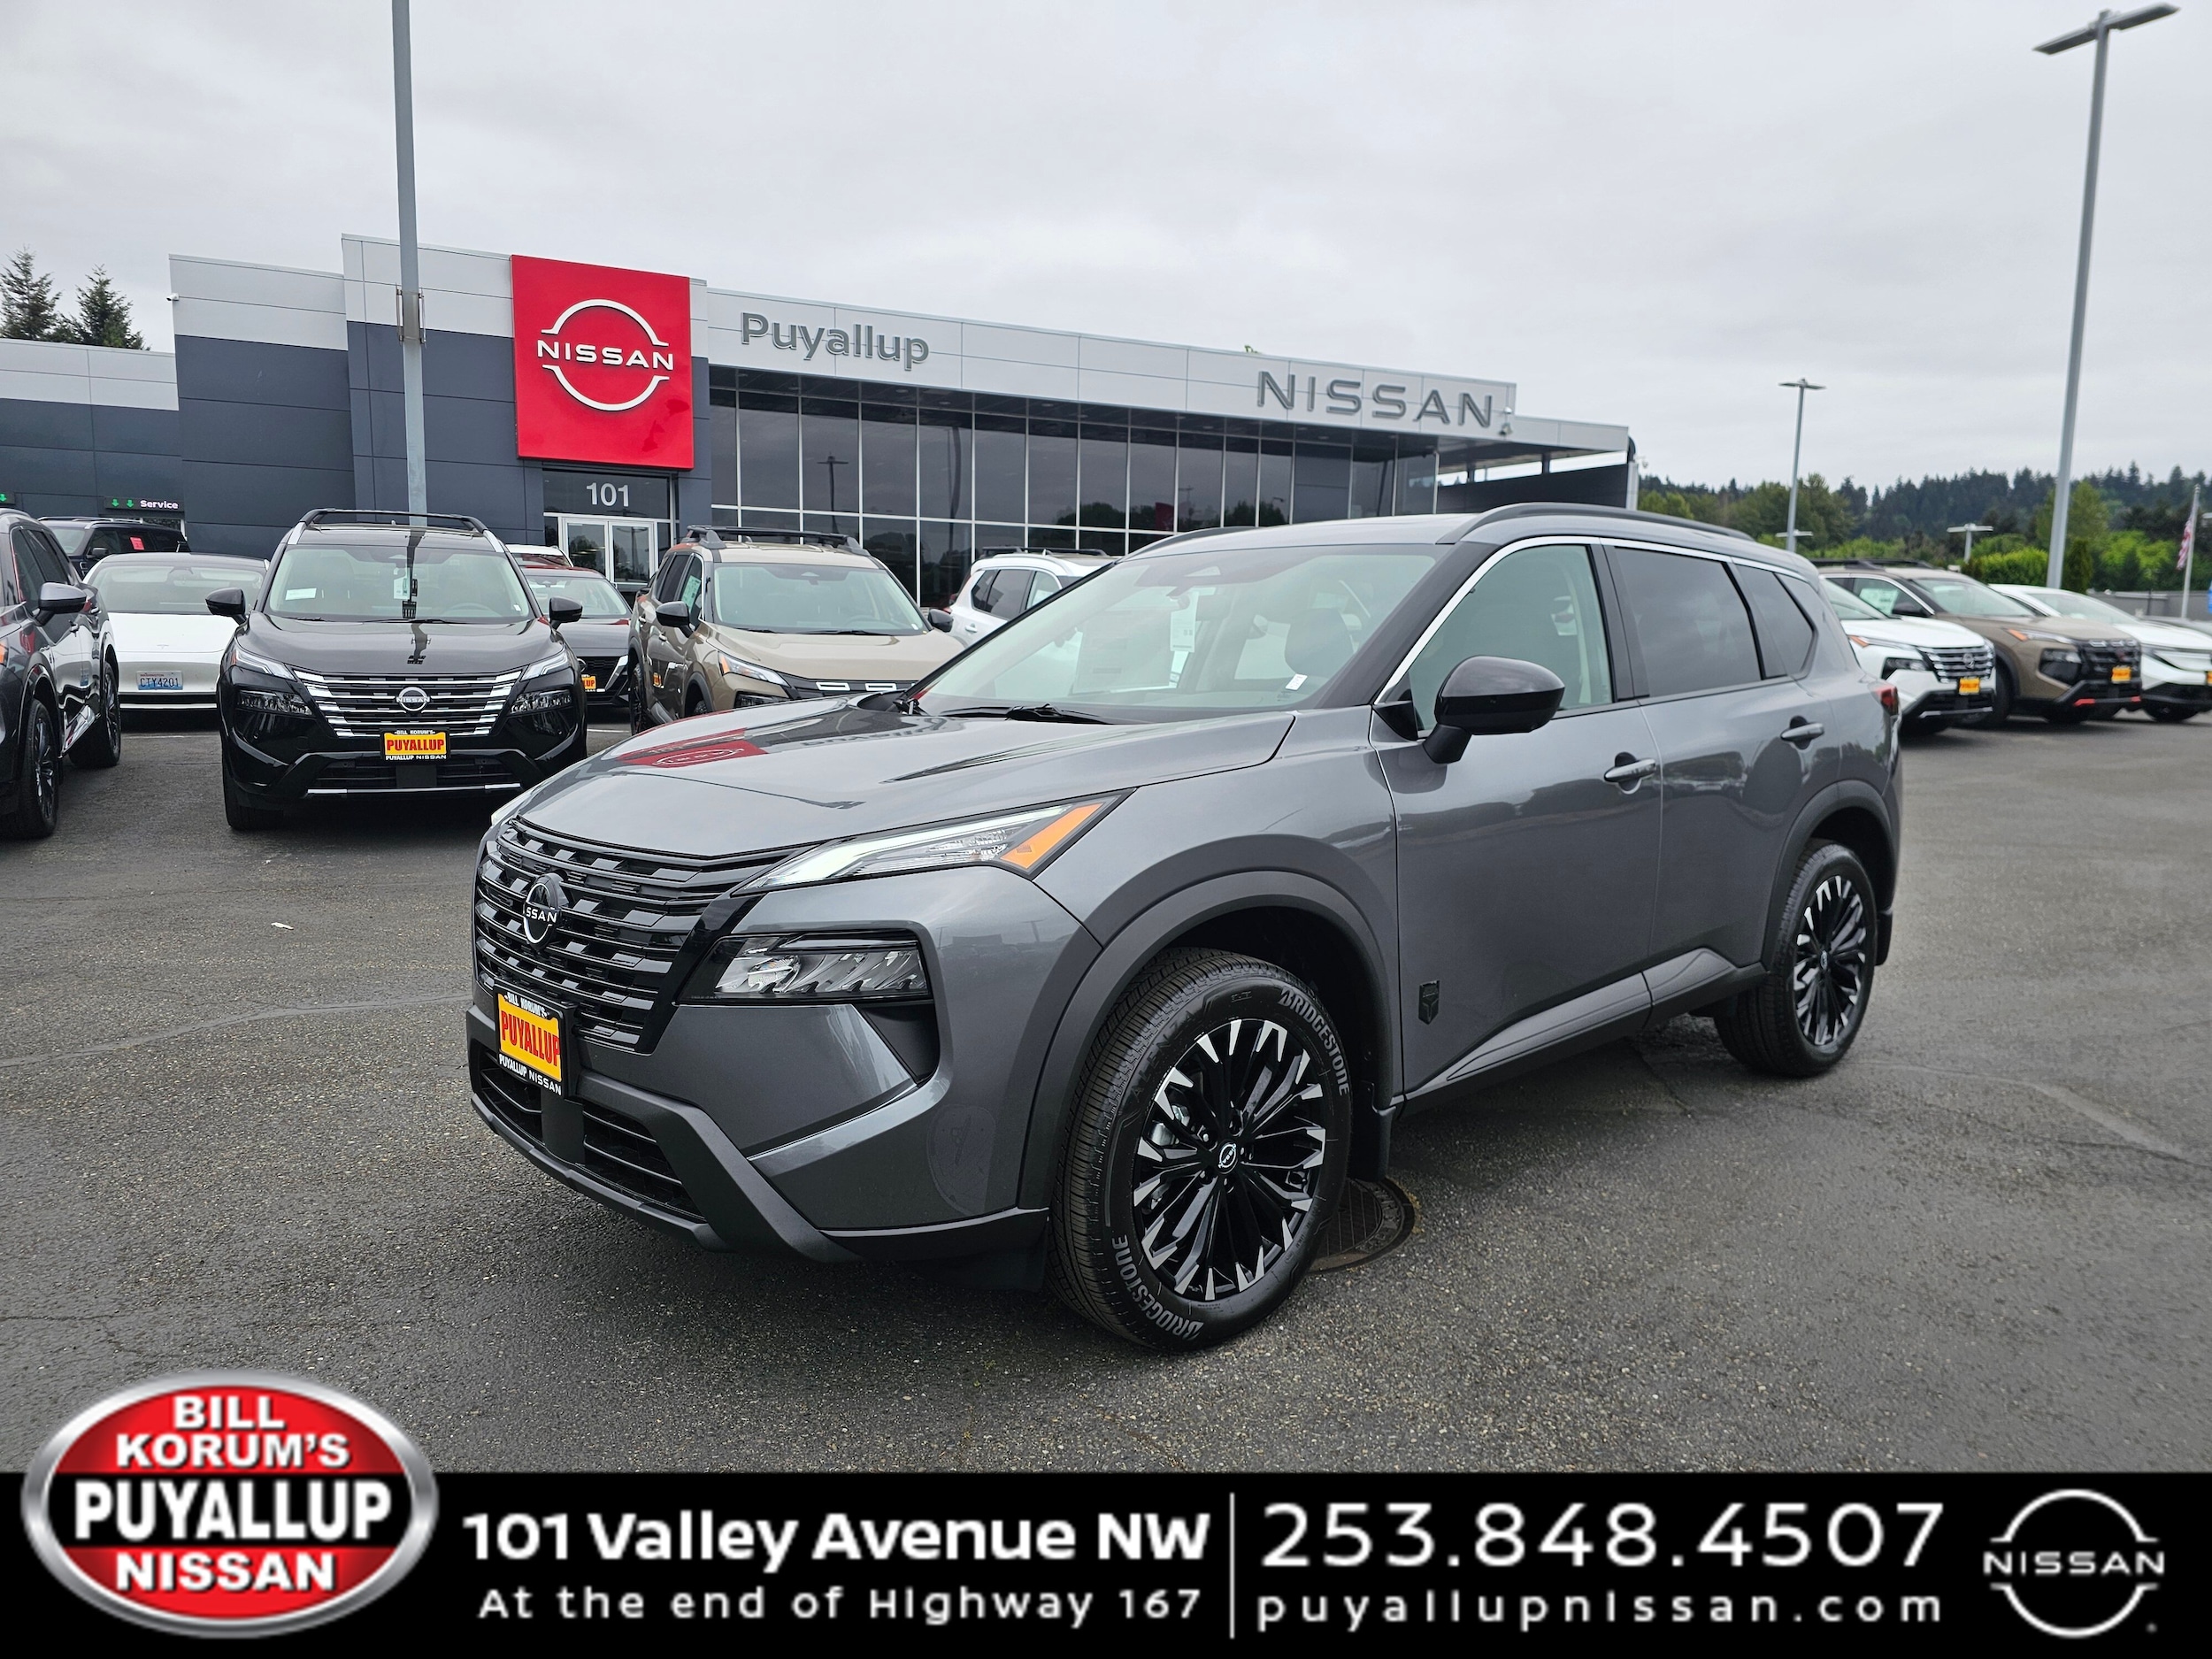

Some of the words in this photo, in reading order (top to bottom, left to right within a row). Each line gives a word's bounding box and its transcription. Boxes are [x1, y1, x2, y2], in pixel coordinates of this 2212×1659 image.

[537, 340, 674, 371] NISSAN
[741, 312, 929, 371] Puyallup
[1257, 371, 1493, 427] NISSAN
[140, 500, 179, 510] Service
[587, 482, 629, 507] 101
[140, 677, 179, 687] CTY4201
[387, 739, 445, 751] PUYALLUP
[507, 992, 519, 1007] BILL
[520, 997, 548, 1018] KORUM'S
[501, 1010, 560, 1067] PUYALLUP
[1278, 988, 1350, 1096] BRIDGESTONE
[498, 1053, 527, 1077] PUYALLUP
[529, 1069, 562, 1096] NISSAN
[1111, 1233, 1204, 1341] BRIDGESTONE
